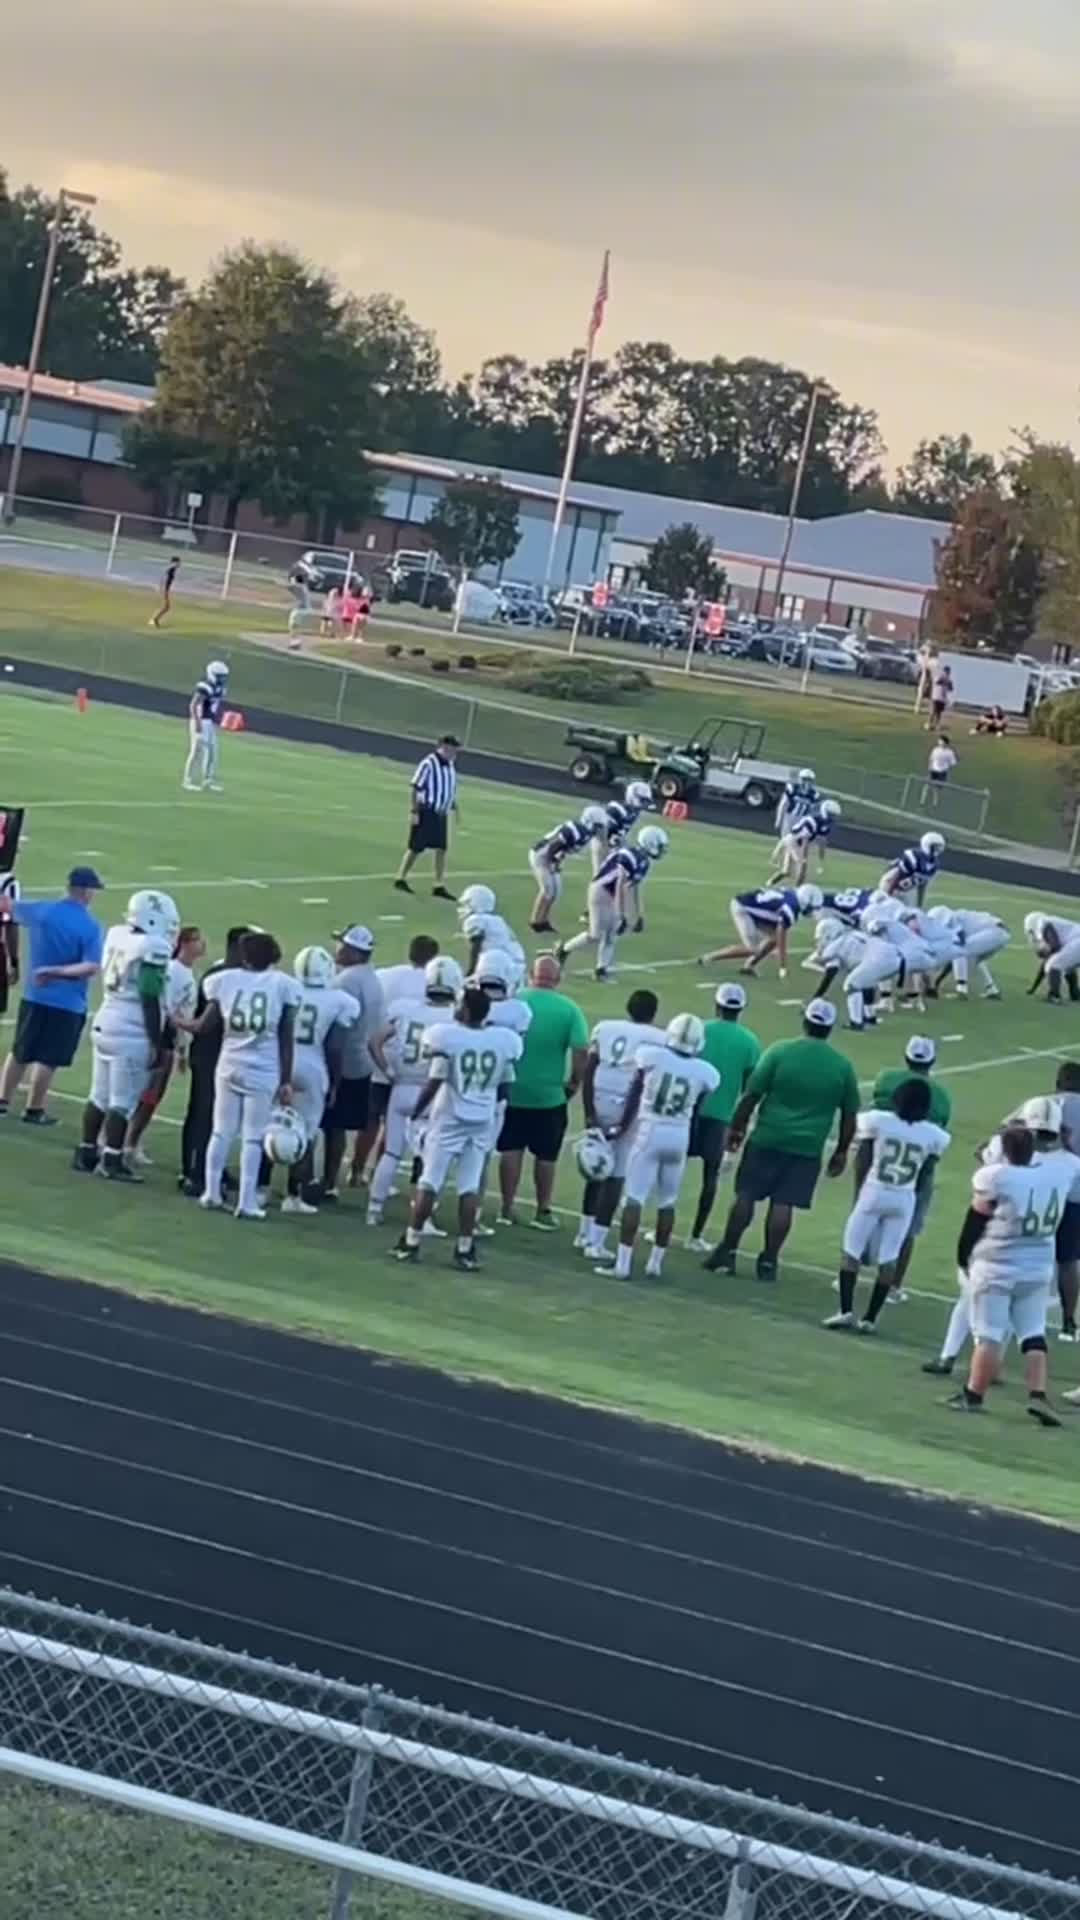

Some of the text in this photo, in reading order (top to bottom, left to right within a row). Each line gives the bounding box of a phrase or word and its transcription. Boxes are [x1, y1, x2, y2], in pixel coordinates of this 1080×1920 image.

[229, 989, 268, 1035] 68
[459, 1049, 497, 1093] 99
[610, 1036, 628, 1067] 9
[652, 1071, 691, 1115] 13
[877, 1137, 923, 1185] 25
[1021, 1187, 1060, 1237] 64
